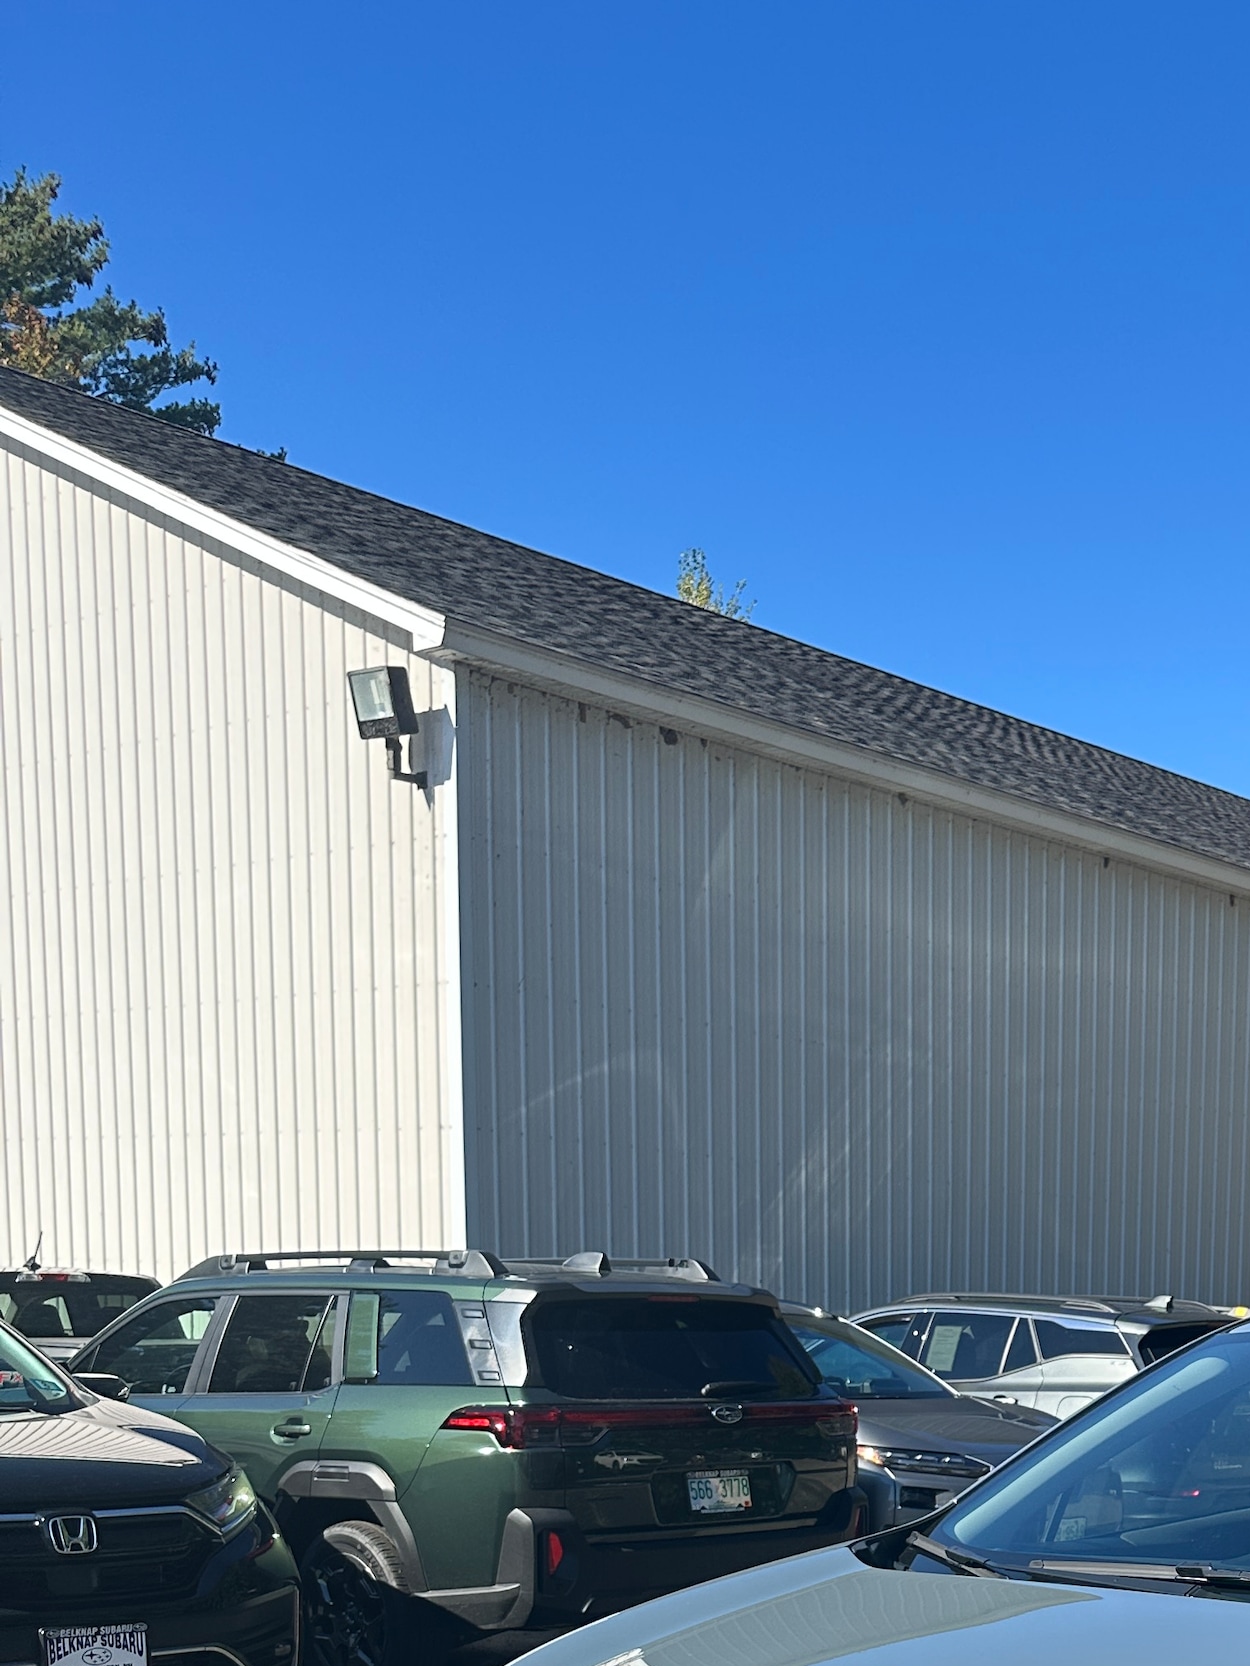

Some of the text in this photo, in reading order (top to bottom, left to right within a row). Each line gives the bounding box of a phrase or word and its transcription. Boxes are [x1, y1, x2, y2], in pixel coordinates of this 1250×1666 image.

[689, 1477, 750, 1500] 566 3778
[60, 1623, 133, 1638] BELKNAP SUBARU
[49, 1631, 144, 1664] BELKNAP SUBARU
